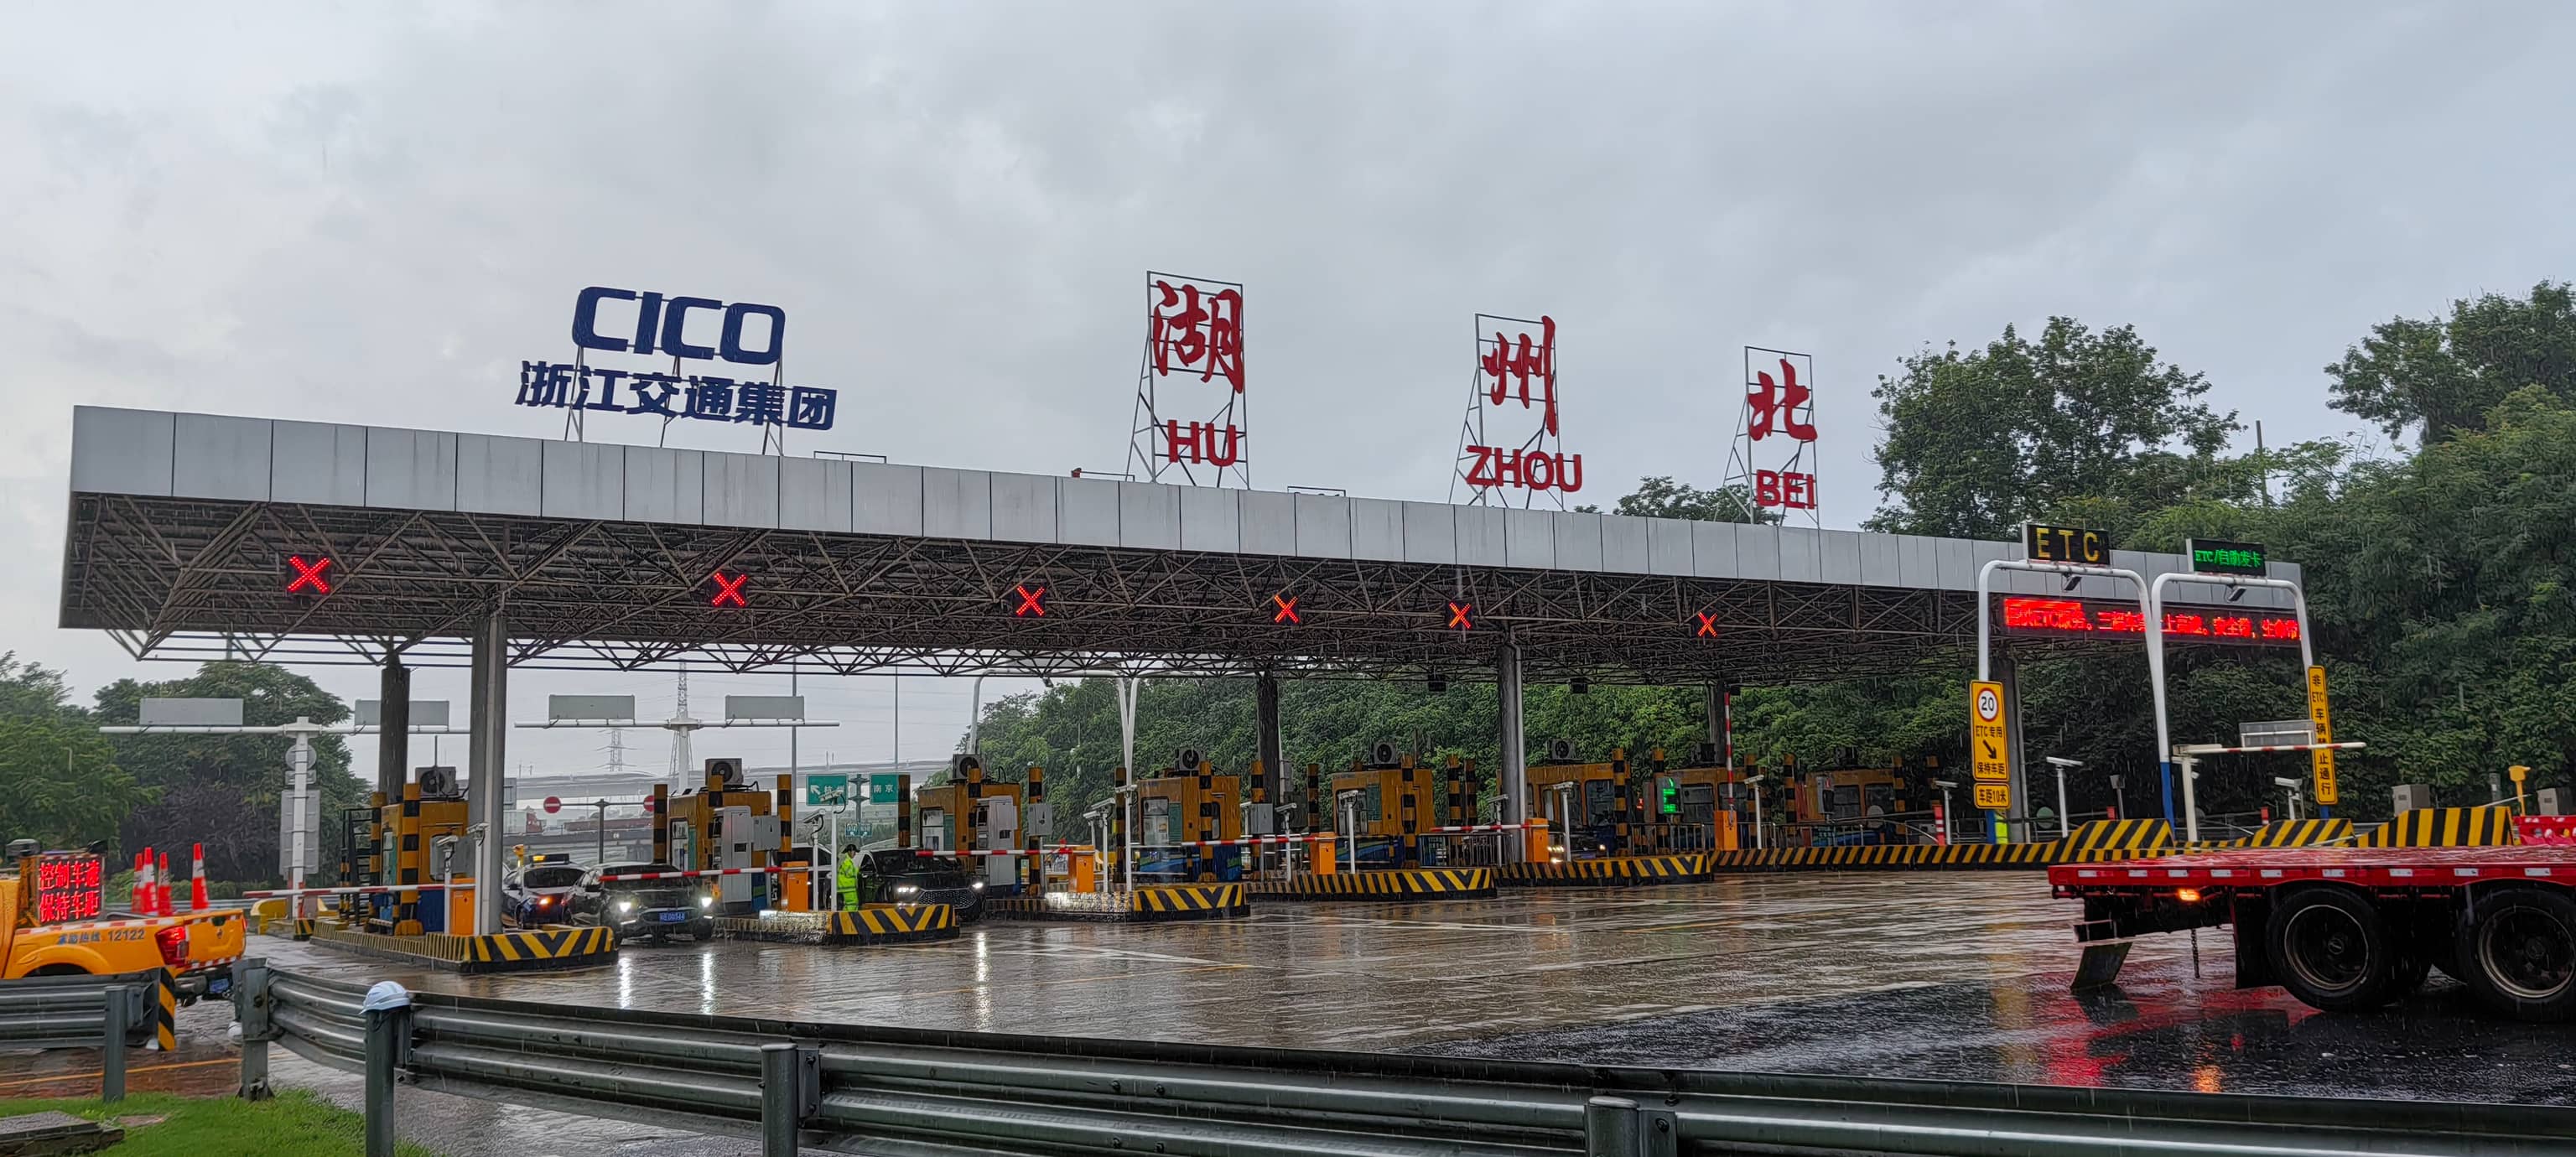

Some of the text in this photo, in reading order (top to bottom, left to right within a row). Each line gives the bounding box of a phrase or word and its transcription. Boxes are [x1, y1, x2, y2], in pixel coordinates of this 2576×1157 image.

[572, 286, 786, 365] CICO
[1153, 280, 1244, 393] 湖
[514, 361, 838, 431] 浙江交通集团
[1482, 315, 1557, 437] 州
[1748, 359, 1818, 441] 北
[1167, 419, 1237, 467] HU
[1465, 445, 1582, 492] ZHOU
[1756, 469, 1815, 510] BEI
[2036, 527, 2100, 562] ETC
[1981, 697, 1995, 712] 20
[873, 783, 894, 794] 南京
[1976, 761, 2005, 776] 保持车距
[1978, 788, 2007, 805] 车距10米
[39, 890, 100, 922] 保持车距
[107, 927, 145, 942] 12122
